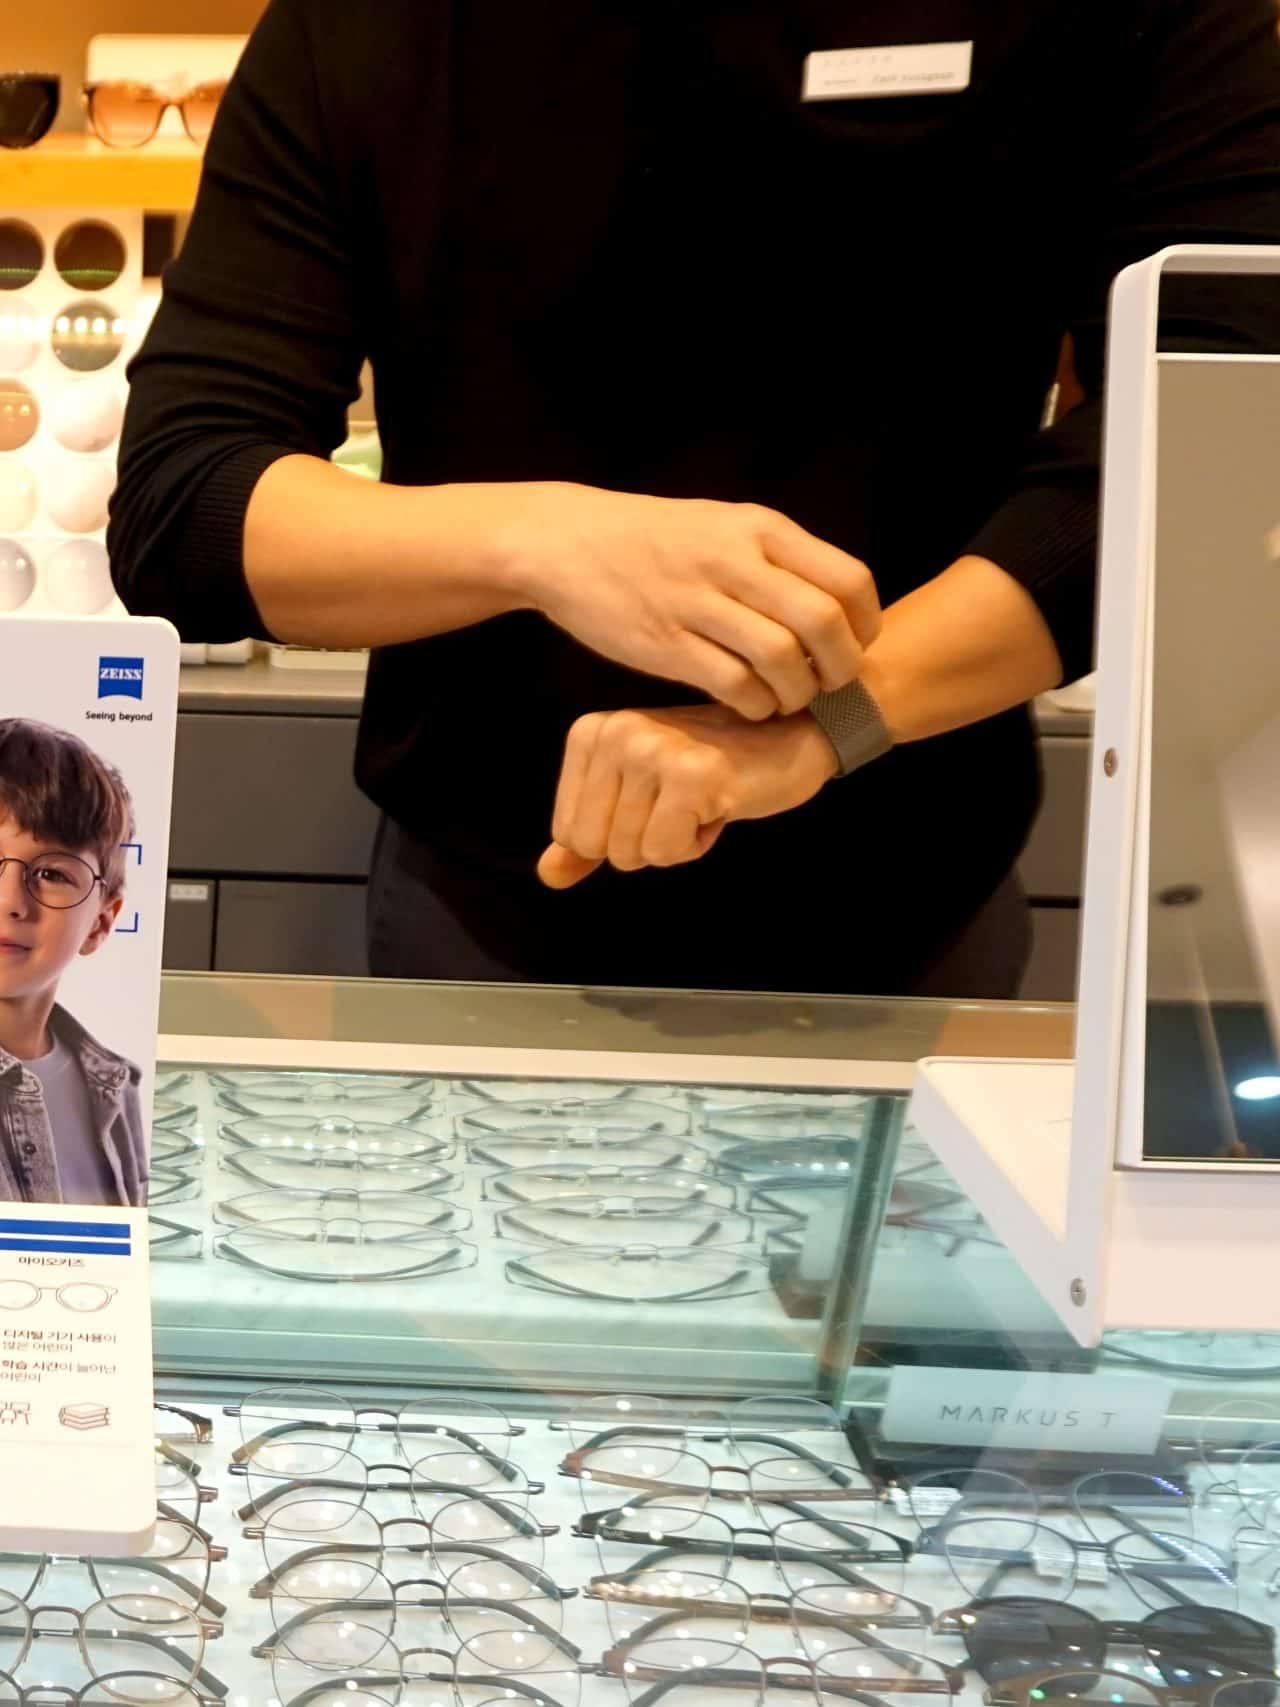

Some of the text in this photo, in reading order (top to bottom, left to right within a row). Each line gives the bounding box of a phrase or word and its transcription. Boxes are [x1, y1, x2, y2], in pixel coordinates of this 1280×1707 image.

[100, 667, 142, 681] ZEISS
[85, 710, 153, 723] Seeing beyond
[938, 1404, 1118, 1429] MARKUS T
